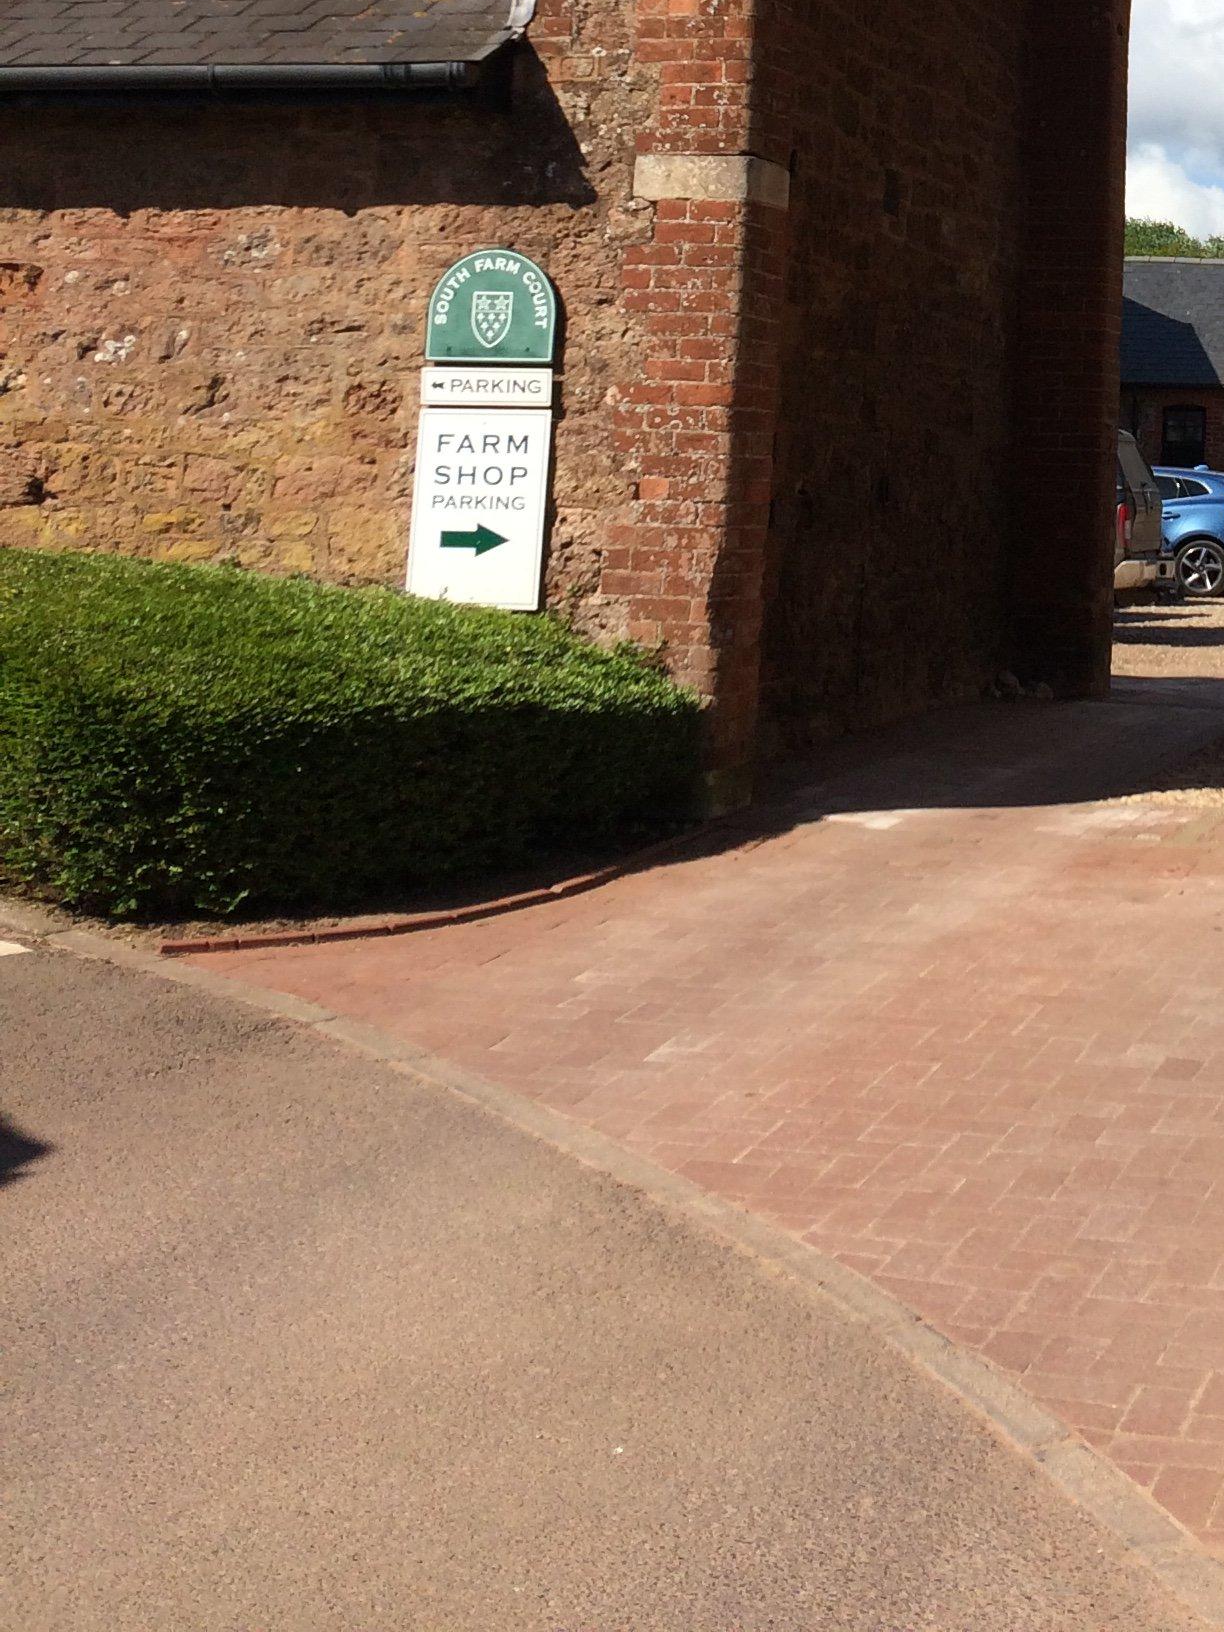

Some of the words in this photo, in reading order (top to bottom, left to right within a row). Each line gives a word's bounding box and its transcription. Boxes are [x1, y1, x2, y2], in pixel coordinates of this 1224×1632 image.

[434, 267, 471, 325] SOUTH
[474, 257, 521, 275] FARM
[522, 271, 548, 329] COURT
[450, 378, 542, 394] PARKING
[437, 434, 529, 454] FARM
[434, 465, 528, 486] SHOP
[432, 495, 526, 511] PARKING
